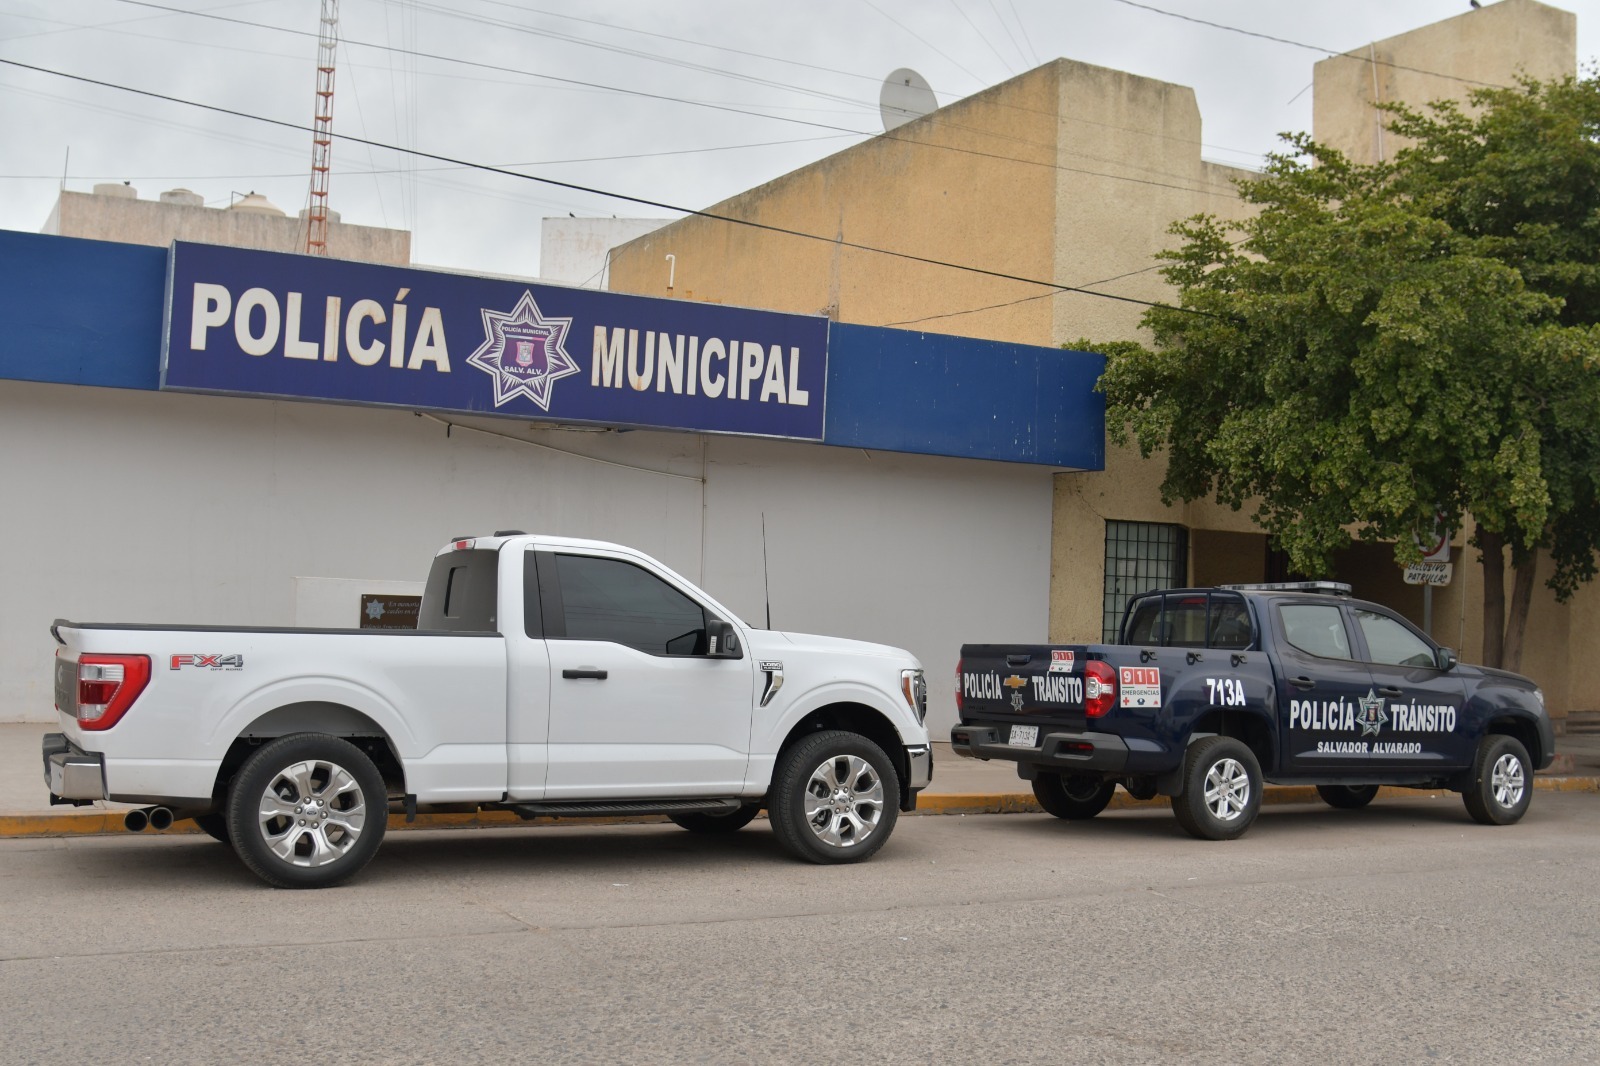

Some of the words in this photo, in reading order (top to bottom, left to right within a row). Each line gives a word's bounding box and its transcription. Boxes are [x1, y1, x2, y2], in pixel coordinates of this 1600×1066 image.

[190, 282, 452, 373] POLICÍA
[591, 325, 809, 406] MUNICIPAL
[170, 654, 243, 670] FX4
[1053, 652, 1074, 660] 911
[964, 670, 1003, 699] POLICÍA
[1031, 671, 1083, 704] TRÁNSITO
[1123, 670, 1156, 683] 911
[1206, 678, 1246, 706] 713A
[1289, 696, 1355, 731] POLICÍA
[1390, 698, 1456, 732] TRÁNSITO
[1317, 741, 1368, 753] SALVADOR
[1372, 742, 1422, 754] ALVARADO
